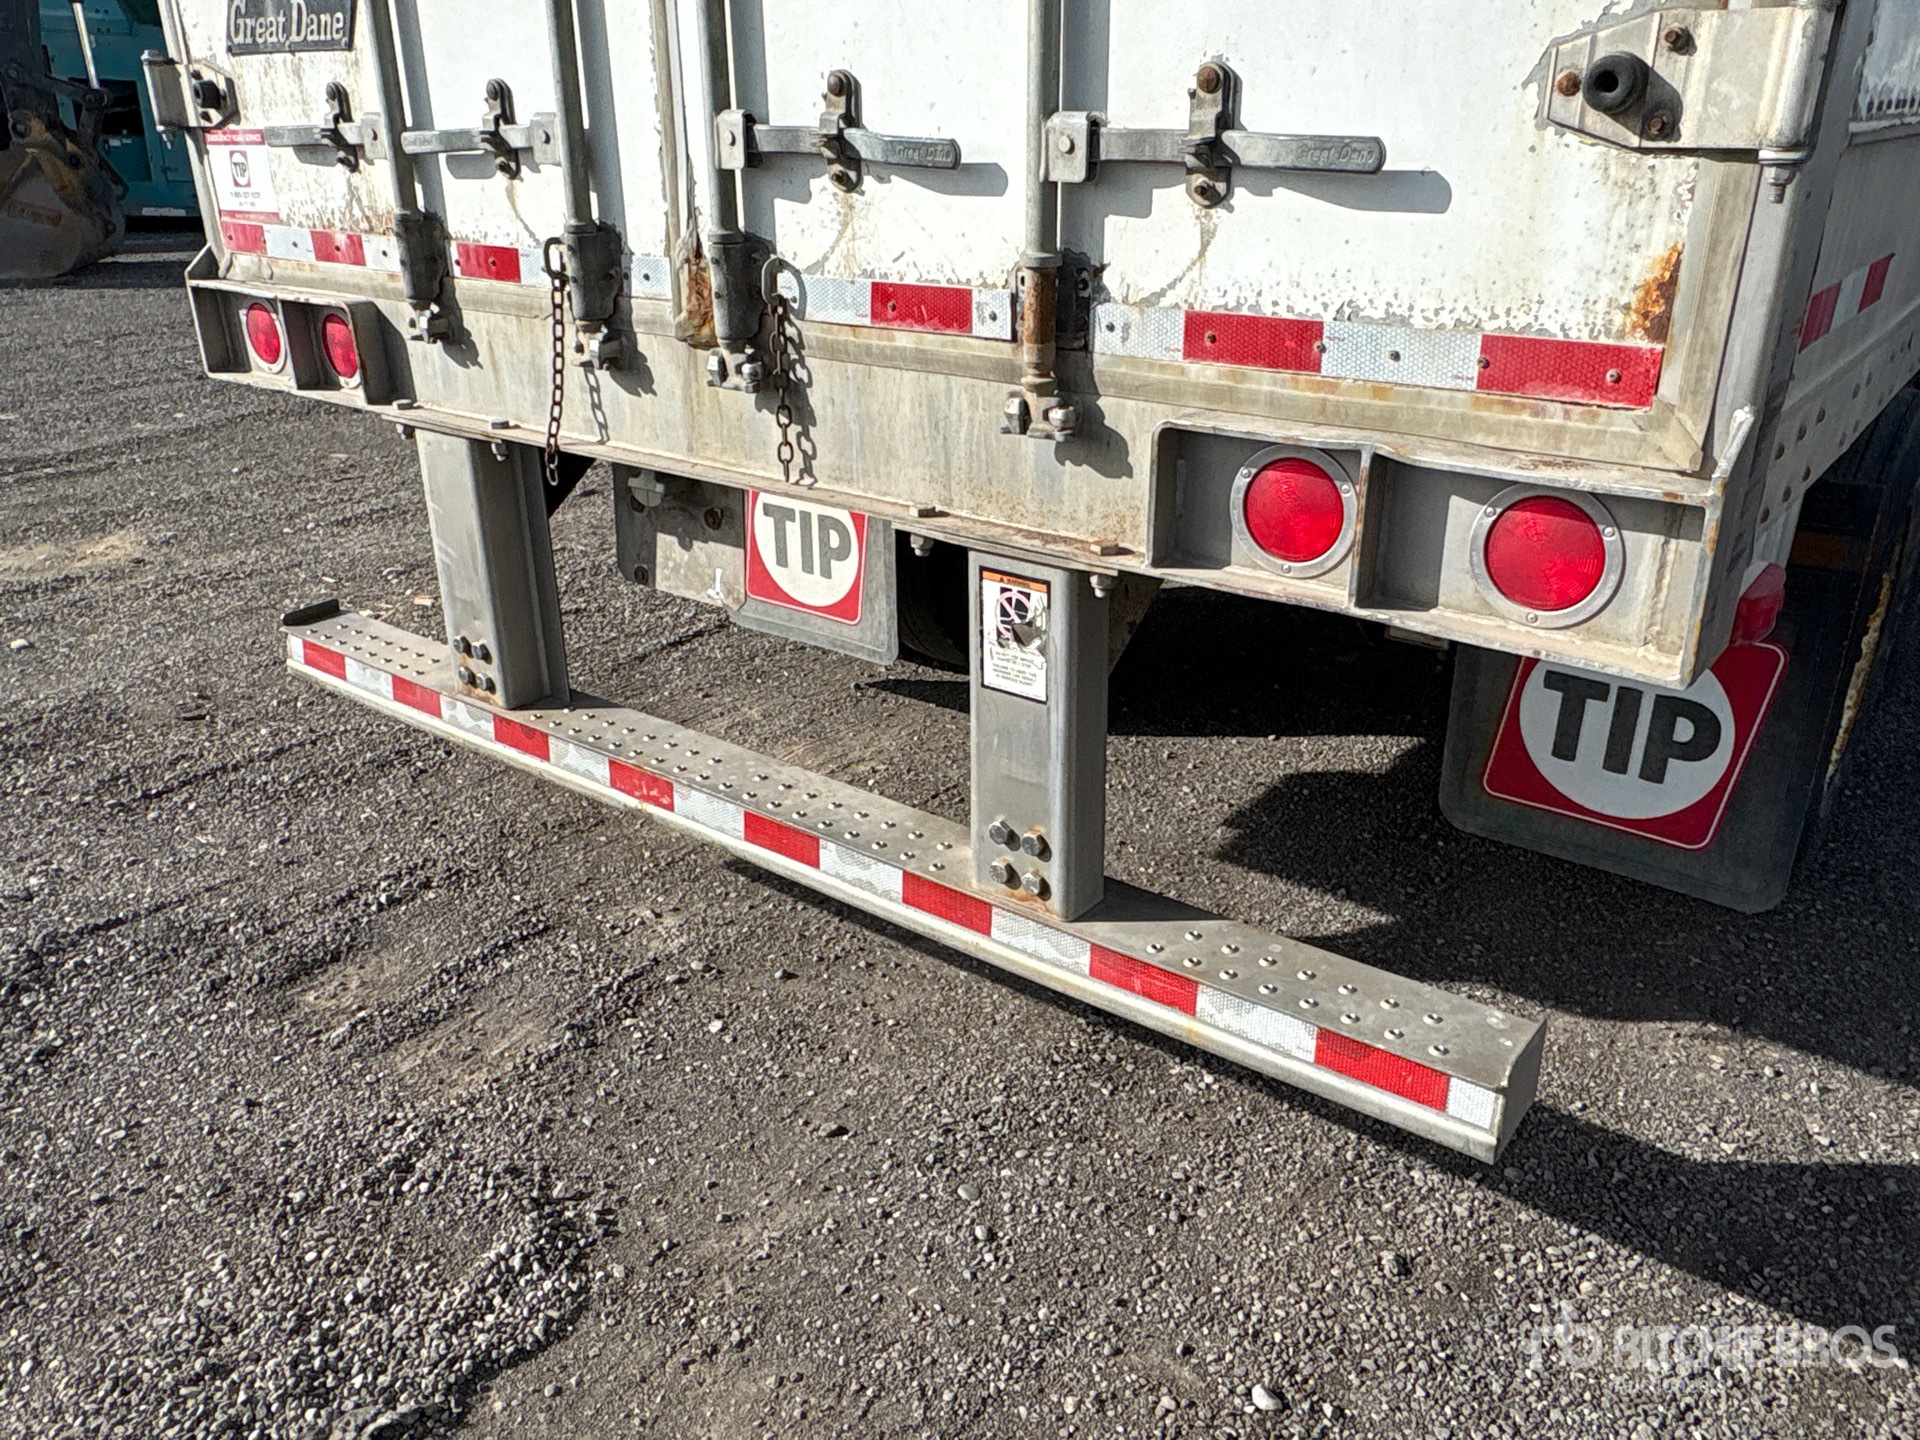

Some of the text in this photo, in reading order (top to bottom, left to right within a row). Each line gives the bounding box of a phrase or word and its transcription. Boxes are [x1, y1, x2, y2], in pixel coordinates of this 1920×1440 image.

[230, 0, 344, 45] Great Dane
[763, 502, 852, 579] TIP
[1544, 670, 1721, 784] TIP
